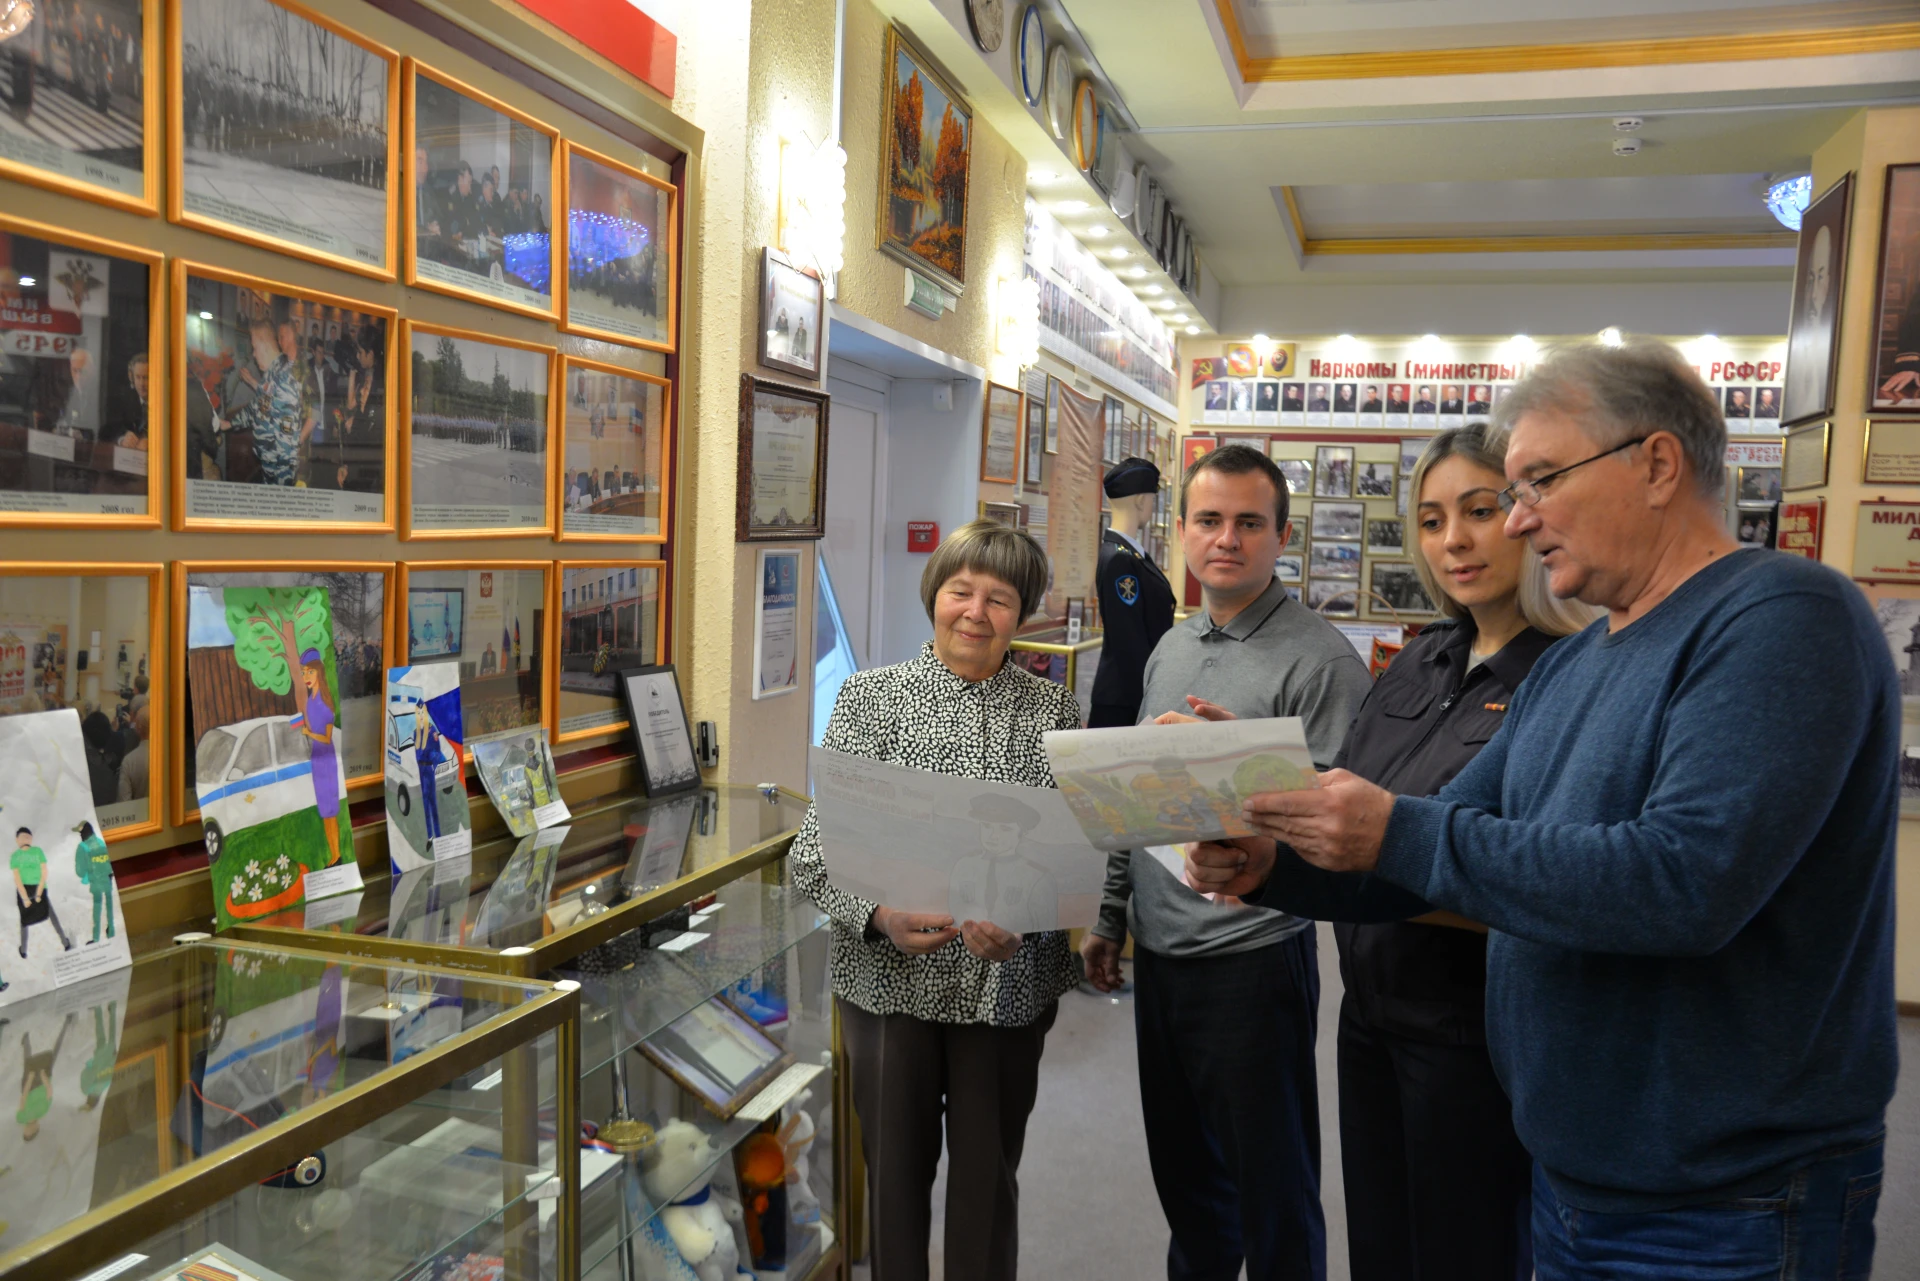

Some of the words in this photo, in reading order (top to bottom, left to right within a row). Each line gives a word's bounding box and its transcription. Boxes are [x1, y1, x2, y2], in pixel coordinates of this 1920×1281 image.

[1309, 359, 1397, 380] Наркомы
[1405, 360, 1525, 381] (министры)
[1710, 361, 1782, 381] РСФСР
[101, 503, 119, 514] 2008
[121, 506, 135, 515] год
[908, 523, 934, 531] ПОЖАР
[101, 815, 120, 828] 2018
[121, 814, 136, 824] год
